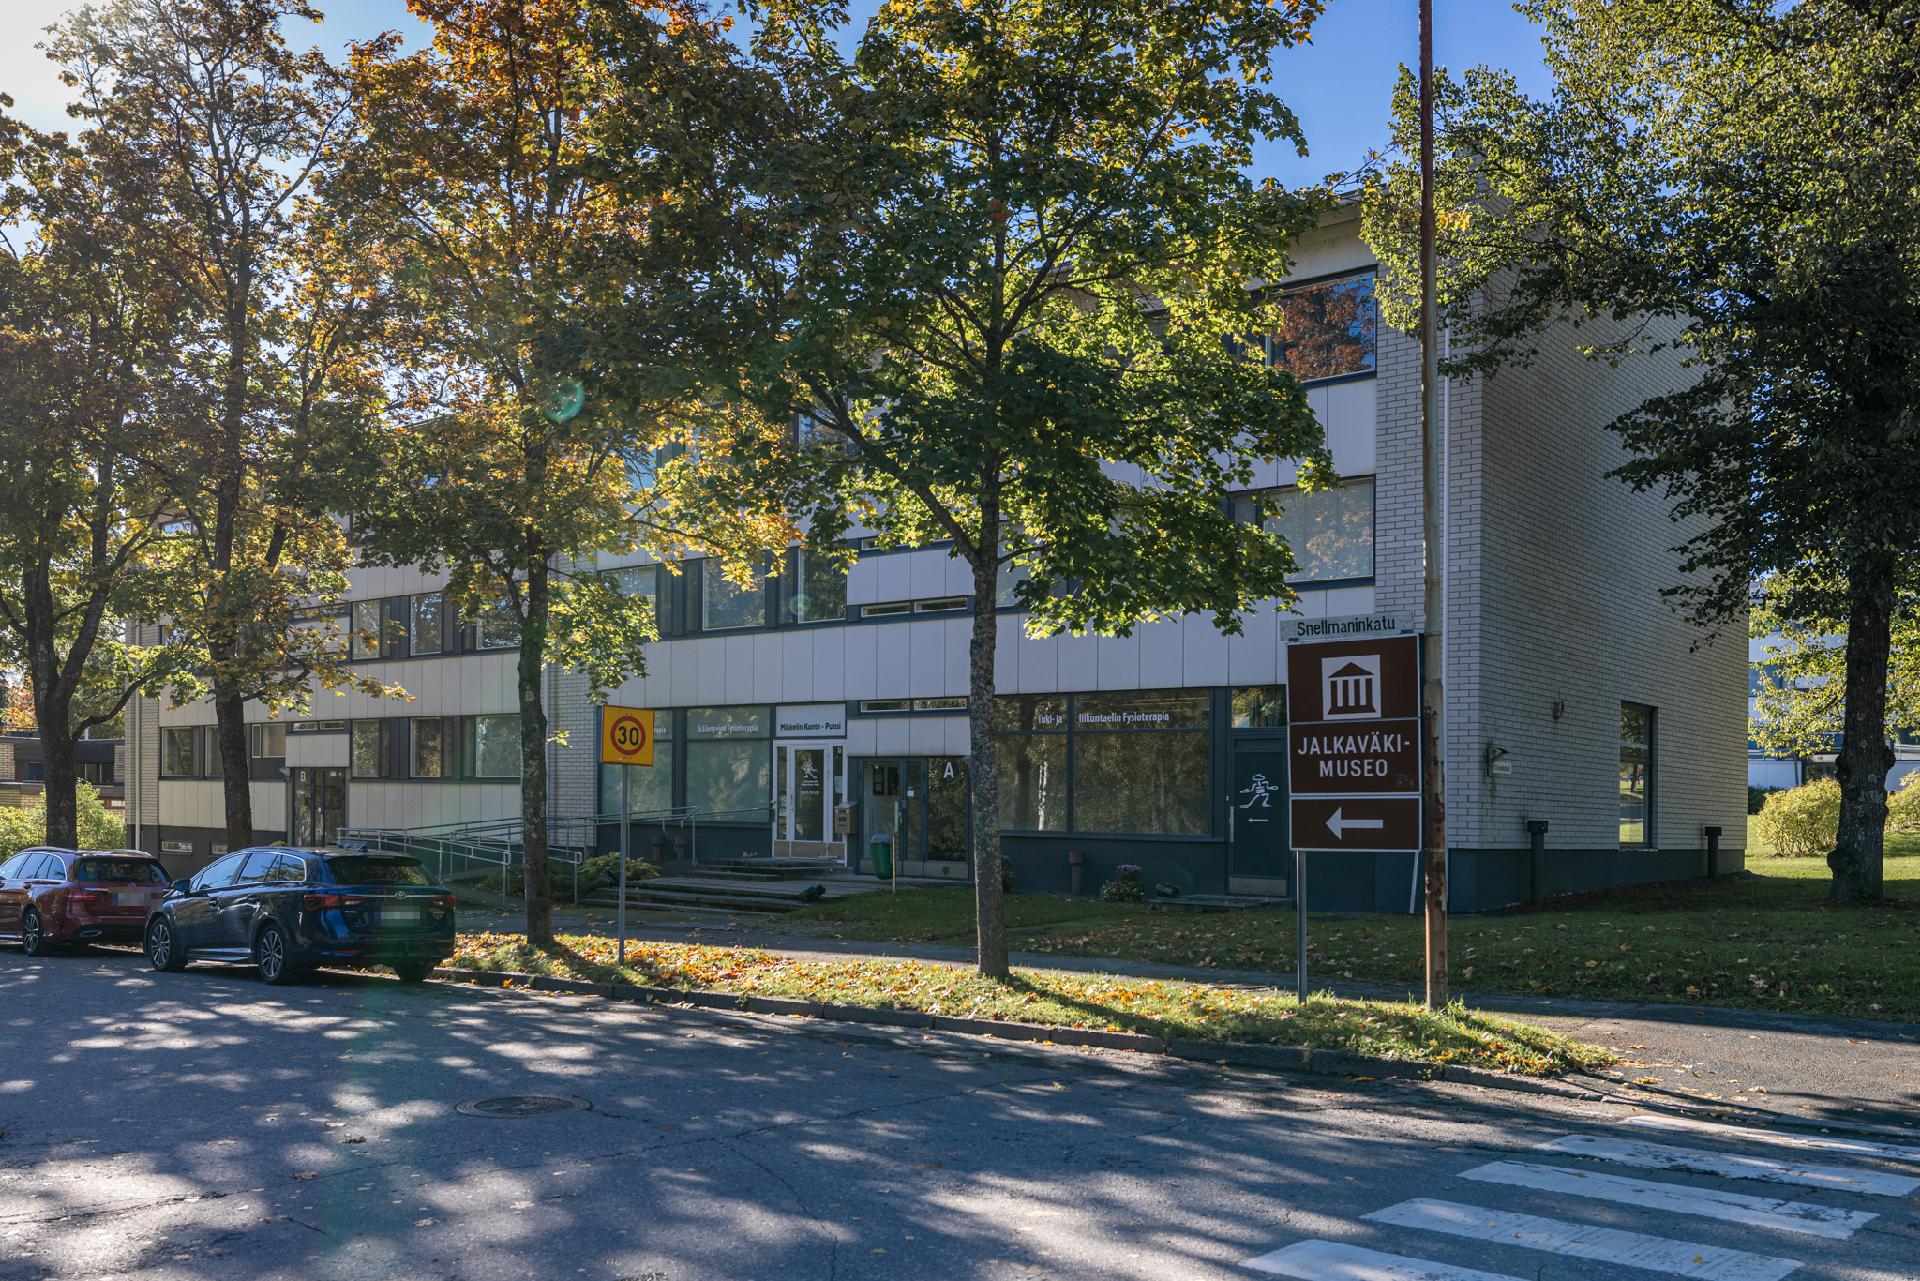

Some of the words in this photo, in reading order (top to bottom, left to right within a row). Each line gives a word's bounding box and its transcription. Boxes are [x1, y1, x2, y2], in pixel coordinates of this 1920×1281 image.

[1297, 615, 1396, 636] Snellmaninkatu
[1038, 714, 1056, 724] Tuki-
[1122, 712, 1169, 724] Fysioterapia
[780, 723, 804, 732] Mikkelin
[804, 722, 820, 731] Kunto
[618, 726, 639, 746] 30
[1297, 731, 1411, 755] JALKAVÄKI-
[943, 762, 954, 778] A
[1319, 759, 1388, 778] MUSEO
